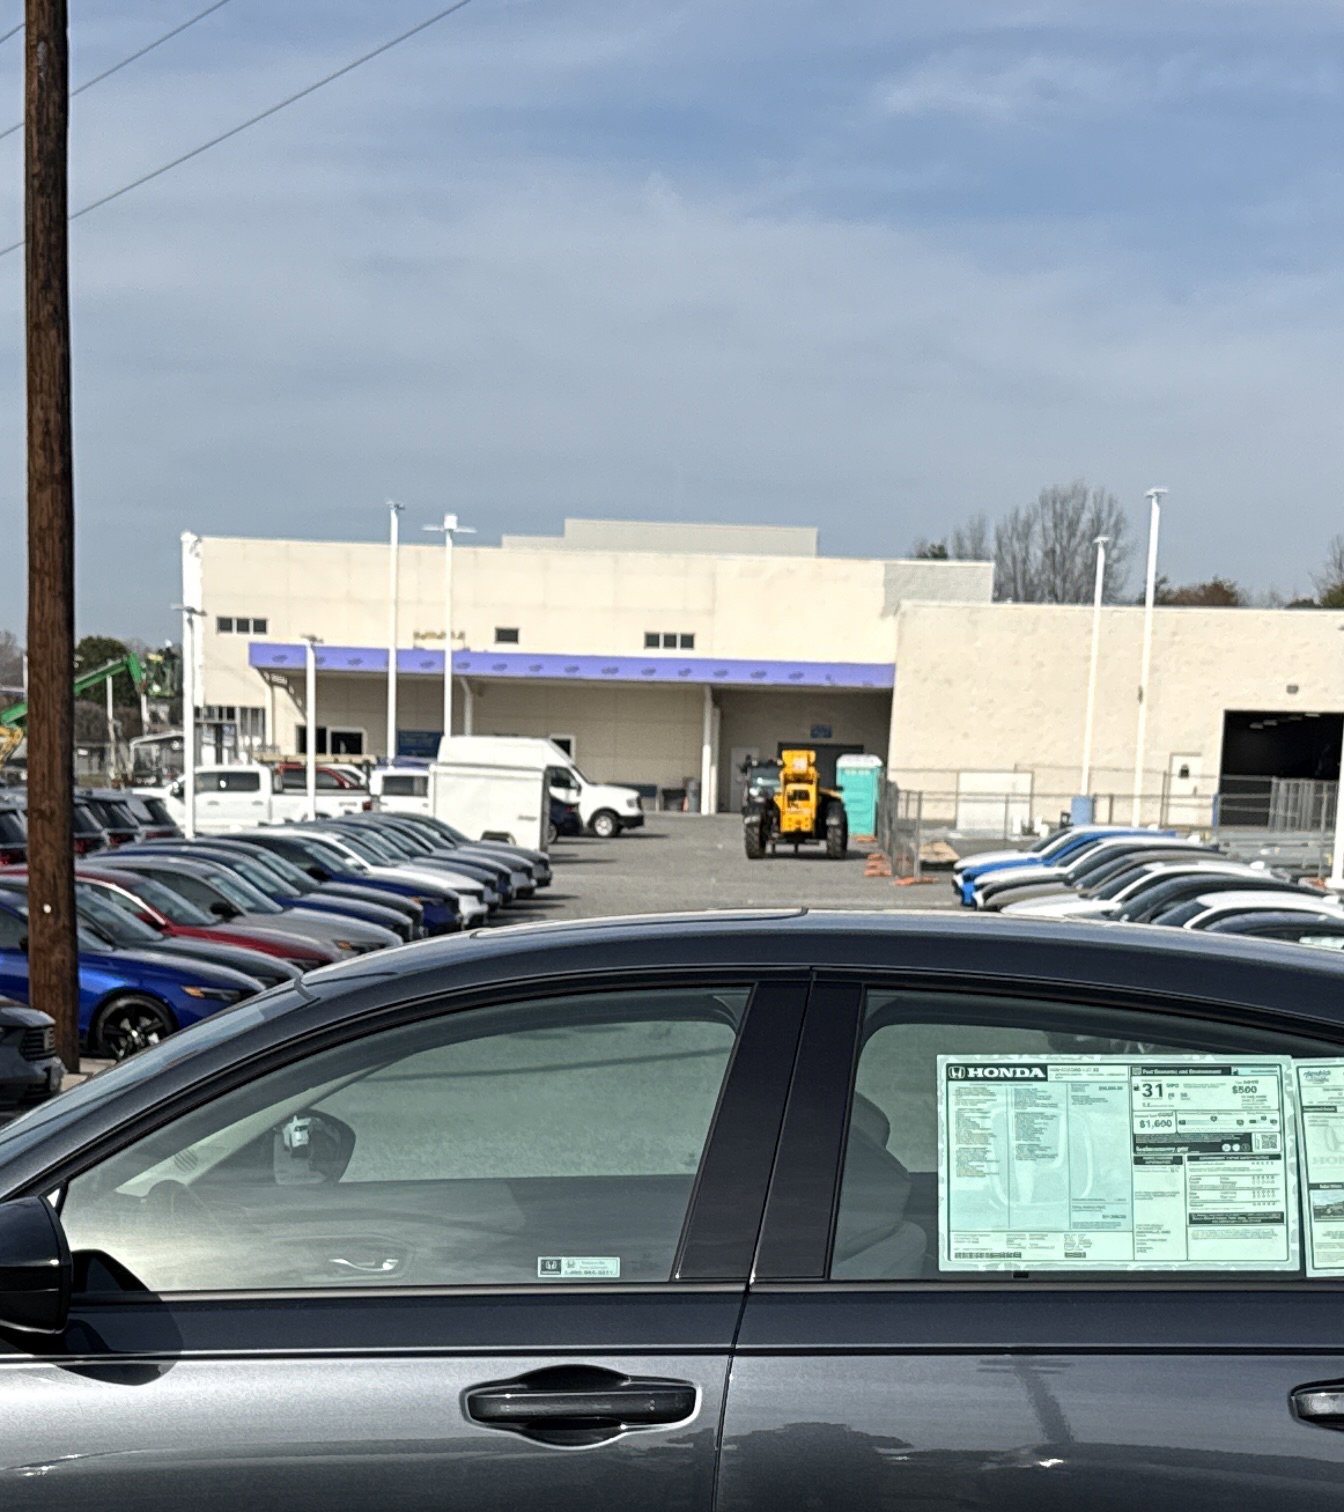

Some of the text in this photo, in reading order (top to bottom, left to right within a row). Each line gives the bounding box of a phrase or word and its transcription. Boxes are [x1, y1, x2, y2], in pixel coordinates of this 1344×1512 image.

[968, 1067, 1046, 1079] HONDA
[1142, 1083, 1163, 1098] 31
[1232, 1085, 1258, 1094] $500
